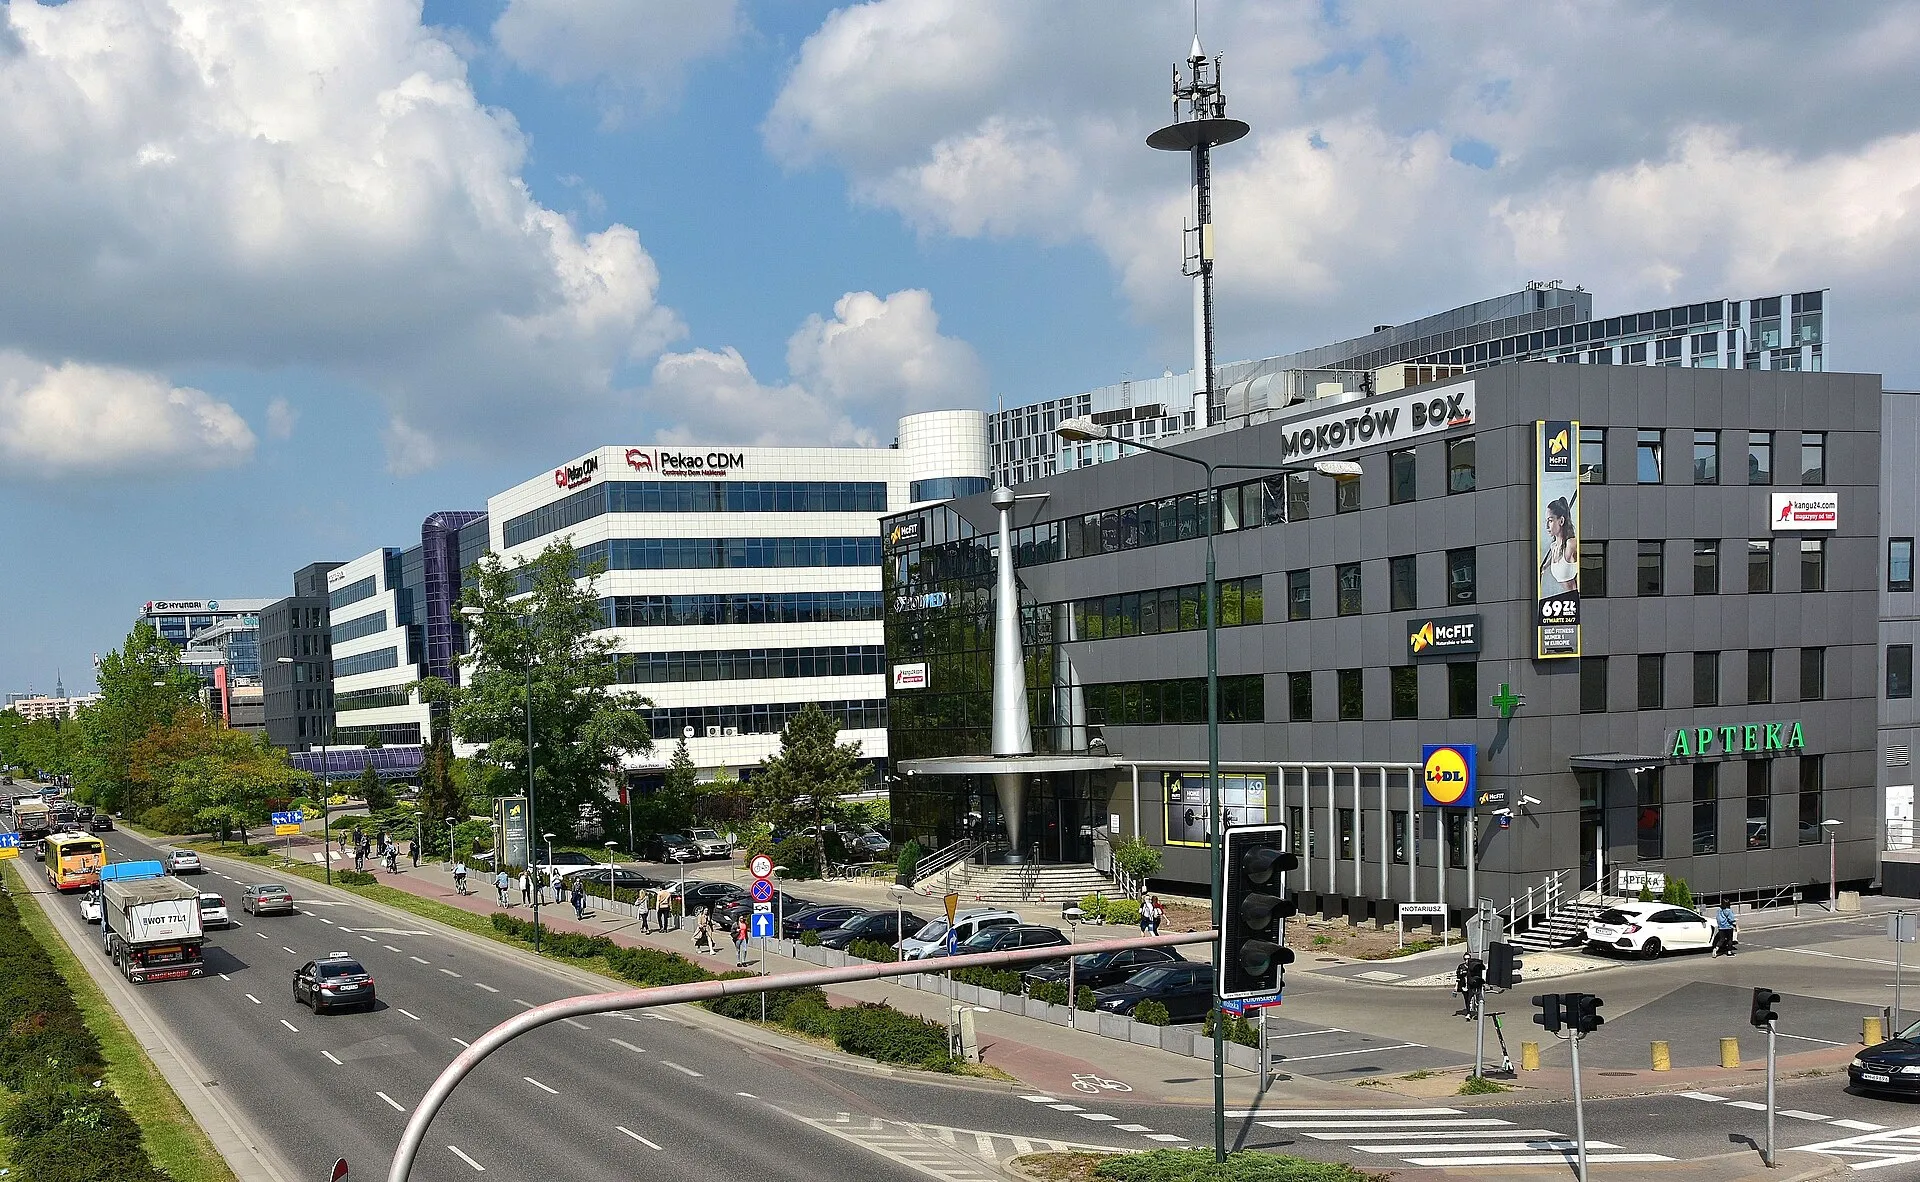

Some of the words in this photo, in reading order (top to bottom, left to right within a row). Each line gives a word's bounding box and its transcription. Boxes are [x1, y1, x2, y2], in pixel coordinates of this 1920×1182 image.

[1282, 407, 1399, 458] MOKOTÓW
[660, 452, 703, 468] Pekao
[706, 452, 744, 468] CDM
[1549, 456, 1568, 464] McFIT
[567, 464, 582, 482] Pekao
[582, 456, 598, 475] CDM
[1794, 501, 1835, 511] kangu24.com
[900, 523, 918, 536] McFIT
[168, 601, 202, 609] HYUNDAI
[1542, 600, 1563, 617] 69
[1435, 623, 1474, 640] McFIT
[1672, 722, 1805, 756] APTEKA
[1248, 781, 1263, 796] 69
[1623, 875, 1659, 886] APTEKA
[147, 916, 166, 925] WOT
